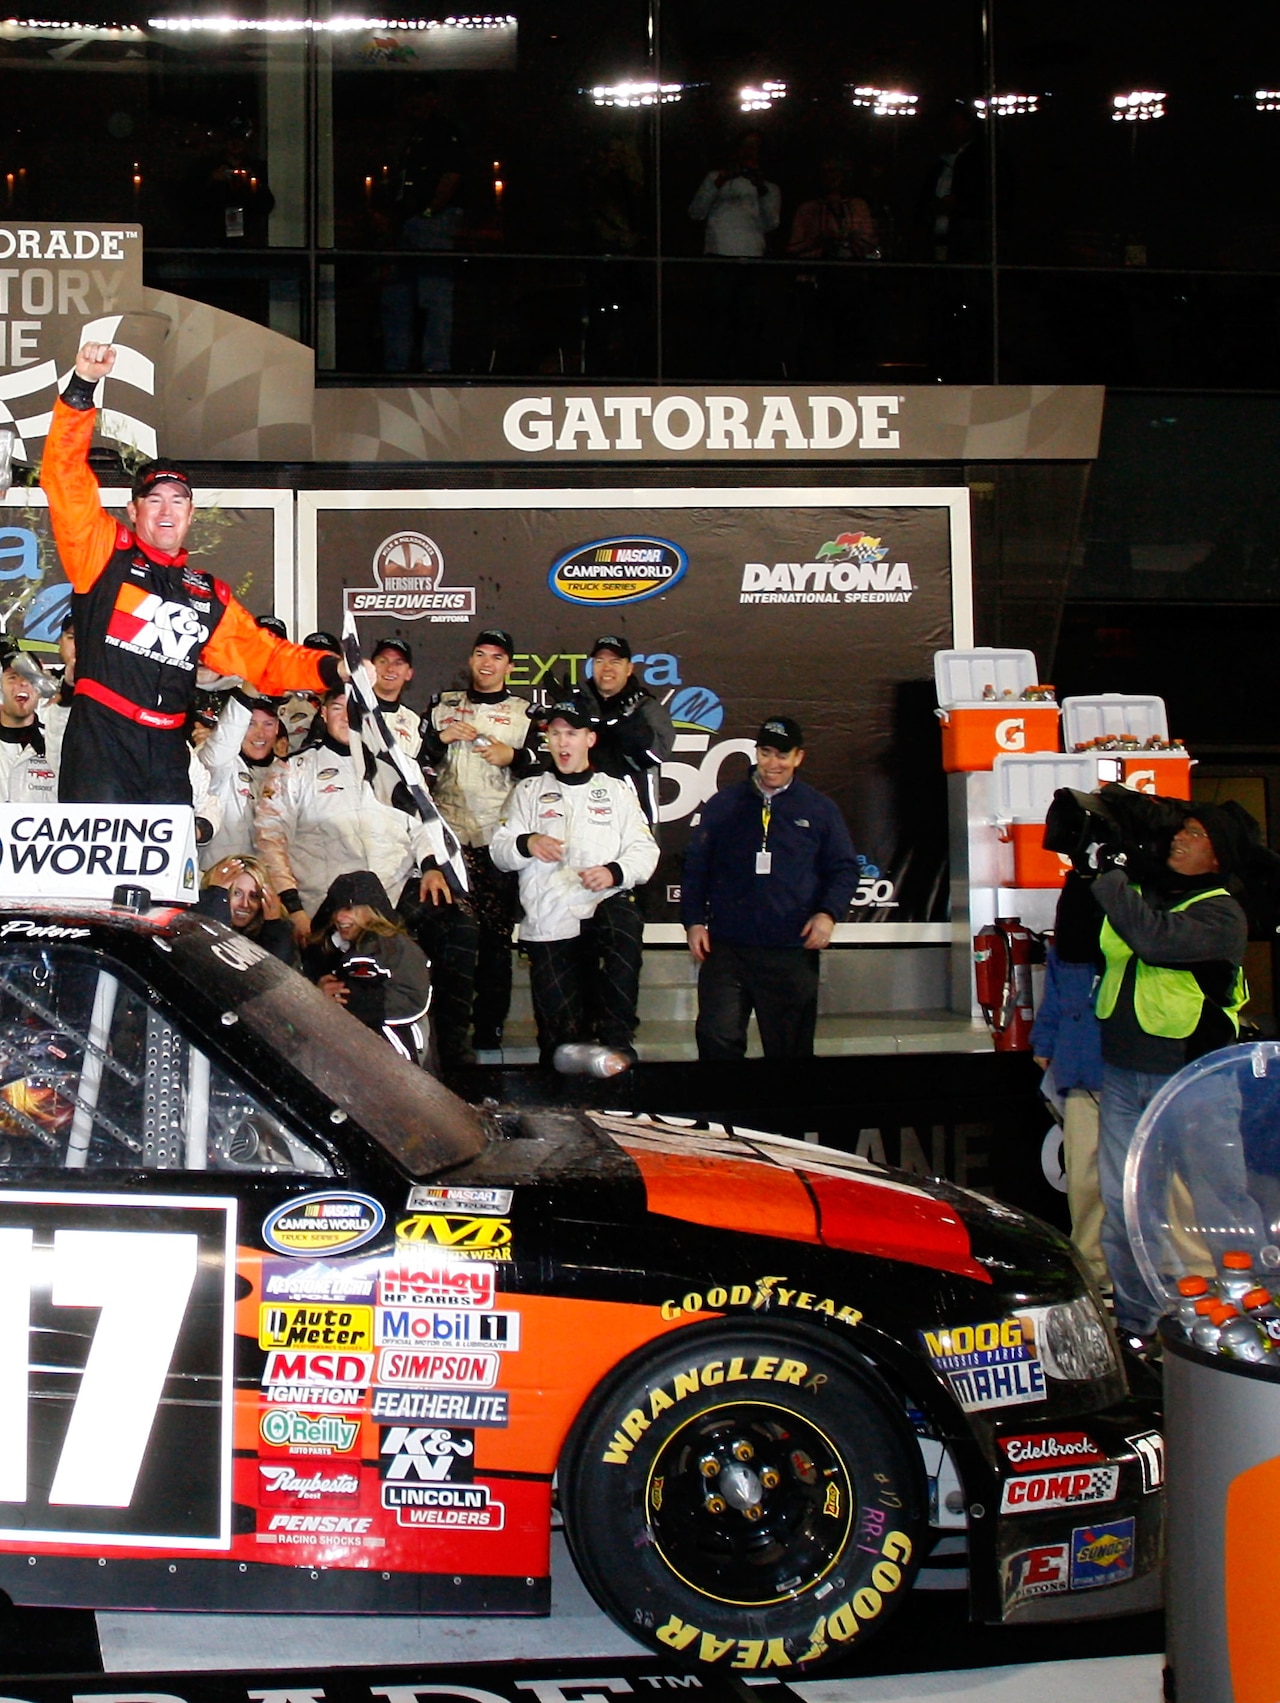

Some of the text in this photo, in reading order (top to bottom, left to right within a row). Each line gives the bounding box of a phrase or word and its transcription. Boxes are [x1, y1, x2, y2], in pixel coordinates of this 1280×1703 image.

[503, 396, 900, 452] GATORADE
[616, 549, 662, 562] NASCAR
[563, 565, 672, 578] CAMPING WORLD
[742, 562, 913, 592] DAYTONA
[384, 577, 432, 591] HERSHEY'S
[354, 594, 466, 609] SPEEDWEEKS
[740, 593, 912, 604] INTERNATIONAL SPEEDWAY
[11, 817, 173, 844] CAMPING
[10, 844, 170, 876] WORLD
[0, 919, 91, 940] Peters
[804, 1122, 996, 1200] ANE
[413, 1199, 503, 1210] RACE TRUCK
[447, 1189, 494, 1201] NASCAR
[321, 1204, 362, 1217] NASCAR
[277, 1218, 371, 1230] CAMPING WORLD
[470, 1248, 512, 1261] WEAR
[384, 1294, 471, 1305] HP CARBS
[292, 1309, 352, 1326] Auto
[382, 1311, 502, 1341] Mobil 1
[288, 1327, 366, 1346] Meter
[923, 1319, 1022, 1358] MOOG
[270, 1354, 366, 1383] MSD
[388, 1354, 488, 1381] SIMPSON
[935, 1347, 1024, 1370] CHASSIS PARTS
[951, 1362, 1045, 1404] MAHLE
[267, 1386, 360, 1404] IGNITION
[372, 1392, 507, 1422] FEATHERLITE
[602, 1356, 808, 1465] WRANGLER
[265, 1412, 354, 1446] O'Reilly
[1006, 1437, 1098, 1463] Edelbrock
[259, 1465, 359, 1499] Raybestos
[1008, 1474, 1091, 1505] COMP
[389, 1488, 482, 1507] LINCOLN
[1065, 1490, 1106, 1503] CAMS
[268, 1515, 373, 1534] PENSKE
[410, 1509, 491, 1525] WELDERS
[278, 1534, 362, 1546] RACING SHOCKS
[1077, 1537, 1133, 1562] SUNOCO
